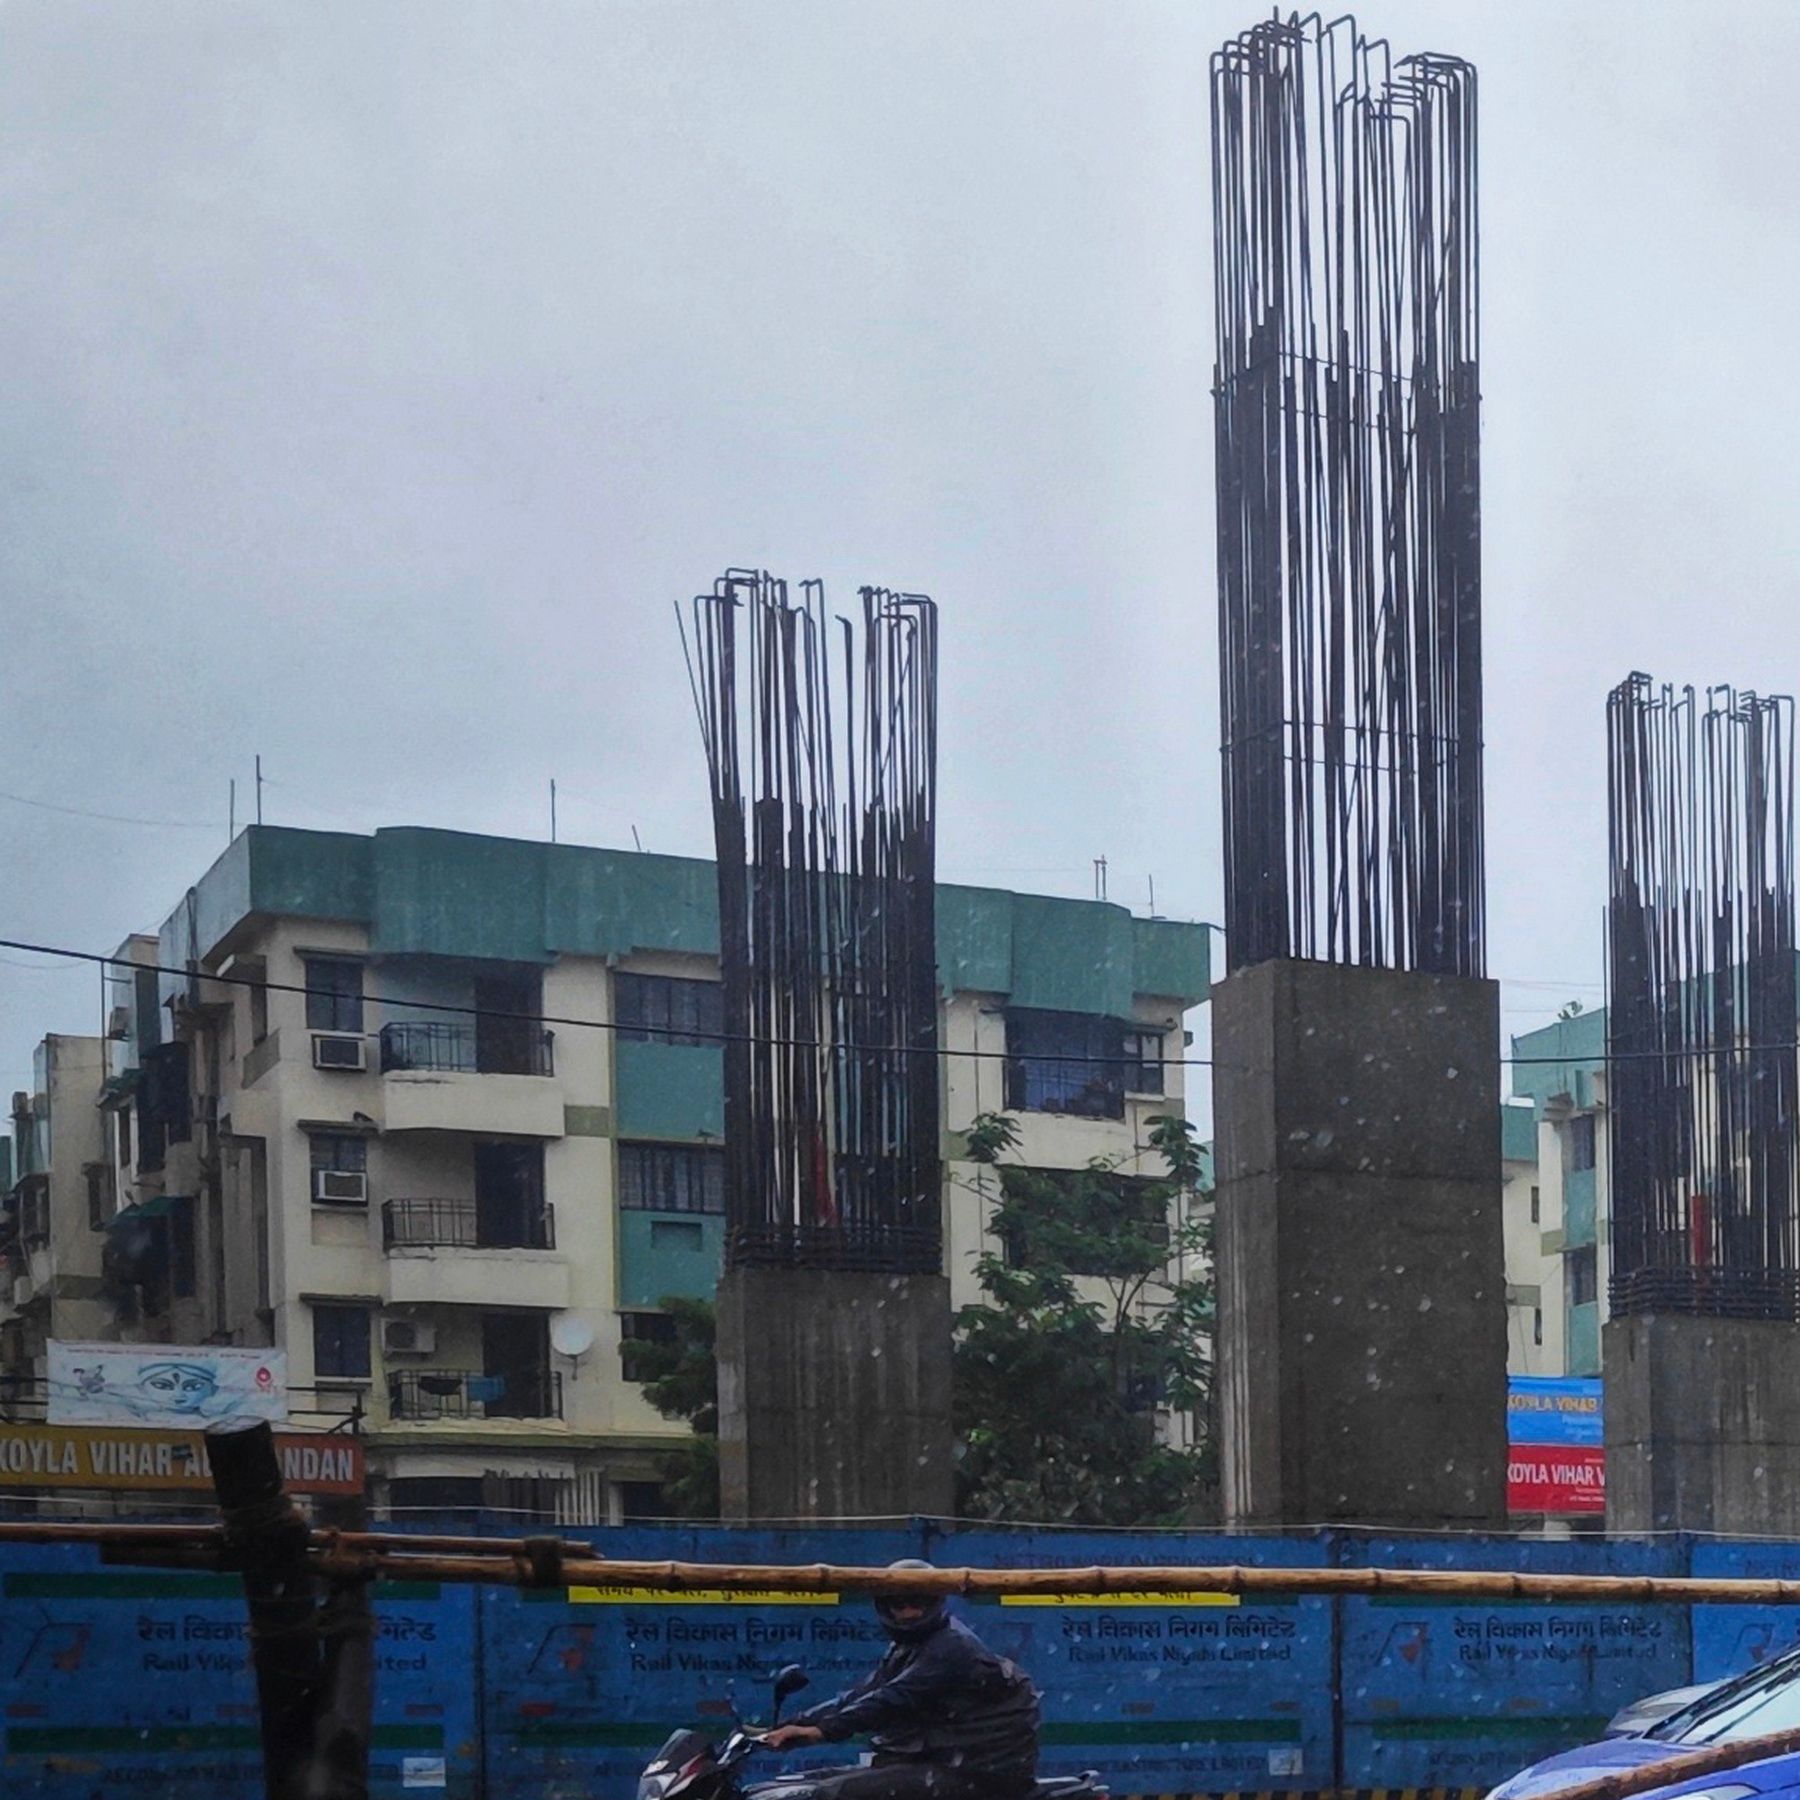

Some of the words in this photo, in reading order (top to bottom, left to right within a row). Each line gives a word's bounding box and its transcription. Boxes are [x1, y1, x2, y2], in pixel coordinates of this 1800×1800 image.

[90, 1441, 173, 1478] VIHAR
[1551, 1465, 1595, 1486] VIHAR
[631, 1650, 672, 1672] Rail
[677, 1651, 732, 1672] Vikas
[1110, 1645, 1158, 1662] Vikas
